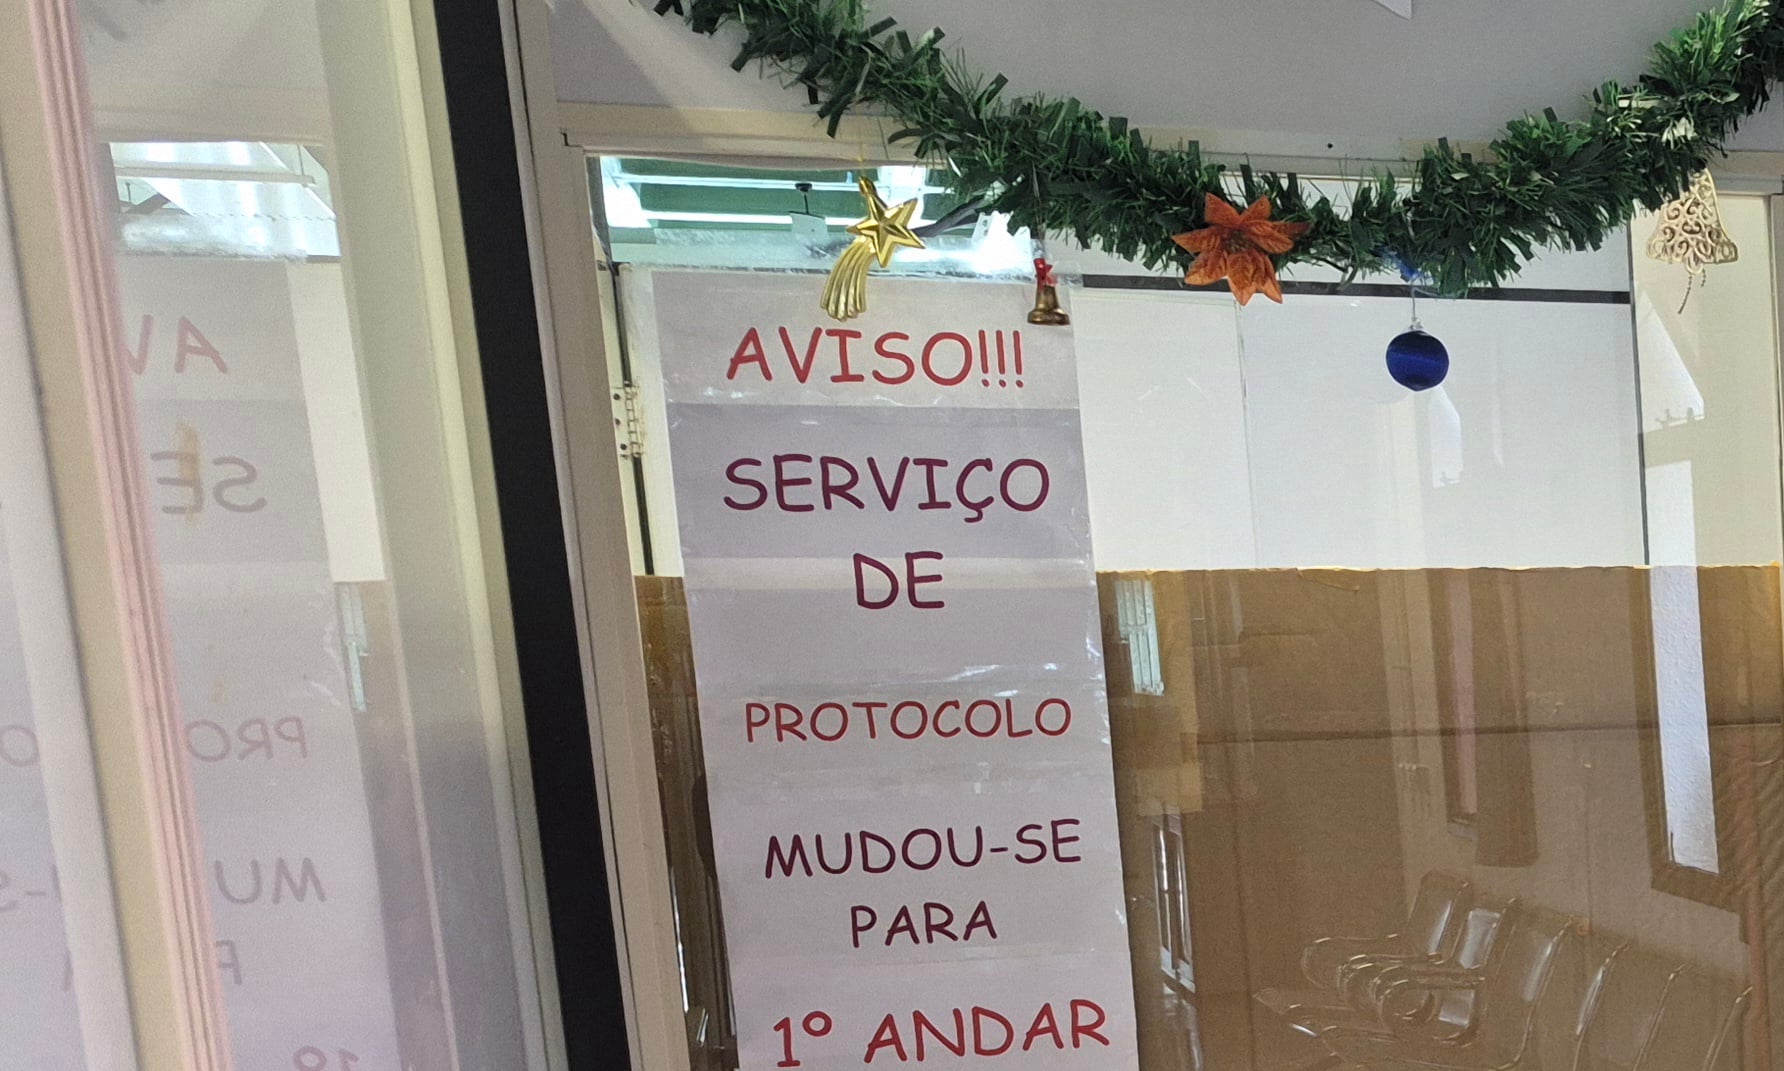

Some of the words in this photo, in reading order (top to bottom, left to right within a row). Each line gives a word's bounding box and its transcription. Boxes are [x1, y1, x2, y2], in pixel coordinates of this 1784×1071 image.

[726, 326, 1026, 388] AVISO!!!
[723, 454, 1050, 524] SERVIÇO
[852, 551, 945, 610] DE
[745, 698, 1072, 743] PROTOCOLO
[764, 818, 1082, 880] MUDOU-SE
[850, 900, 998, 949] PARA
[773, 1010, 833, 1068] 1º
[863, 998, 1110, 1064] ANDAR
